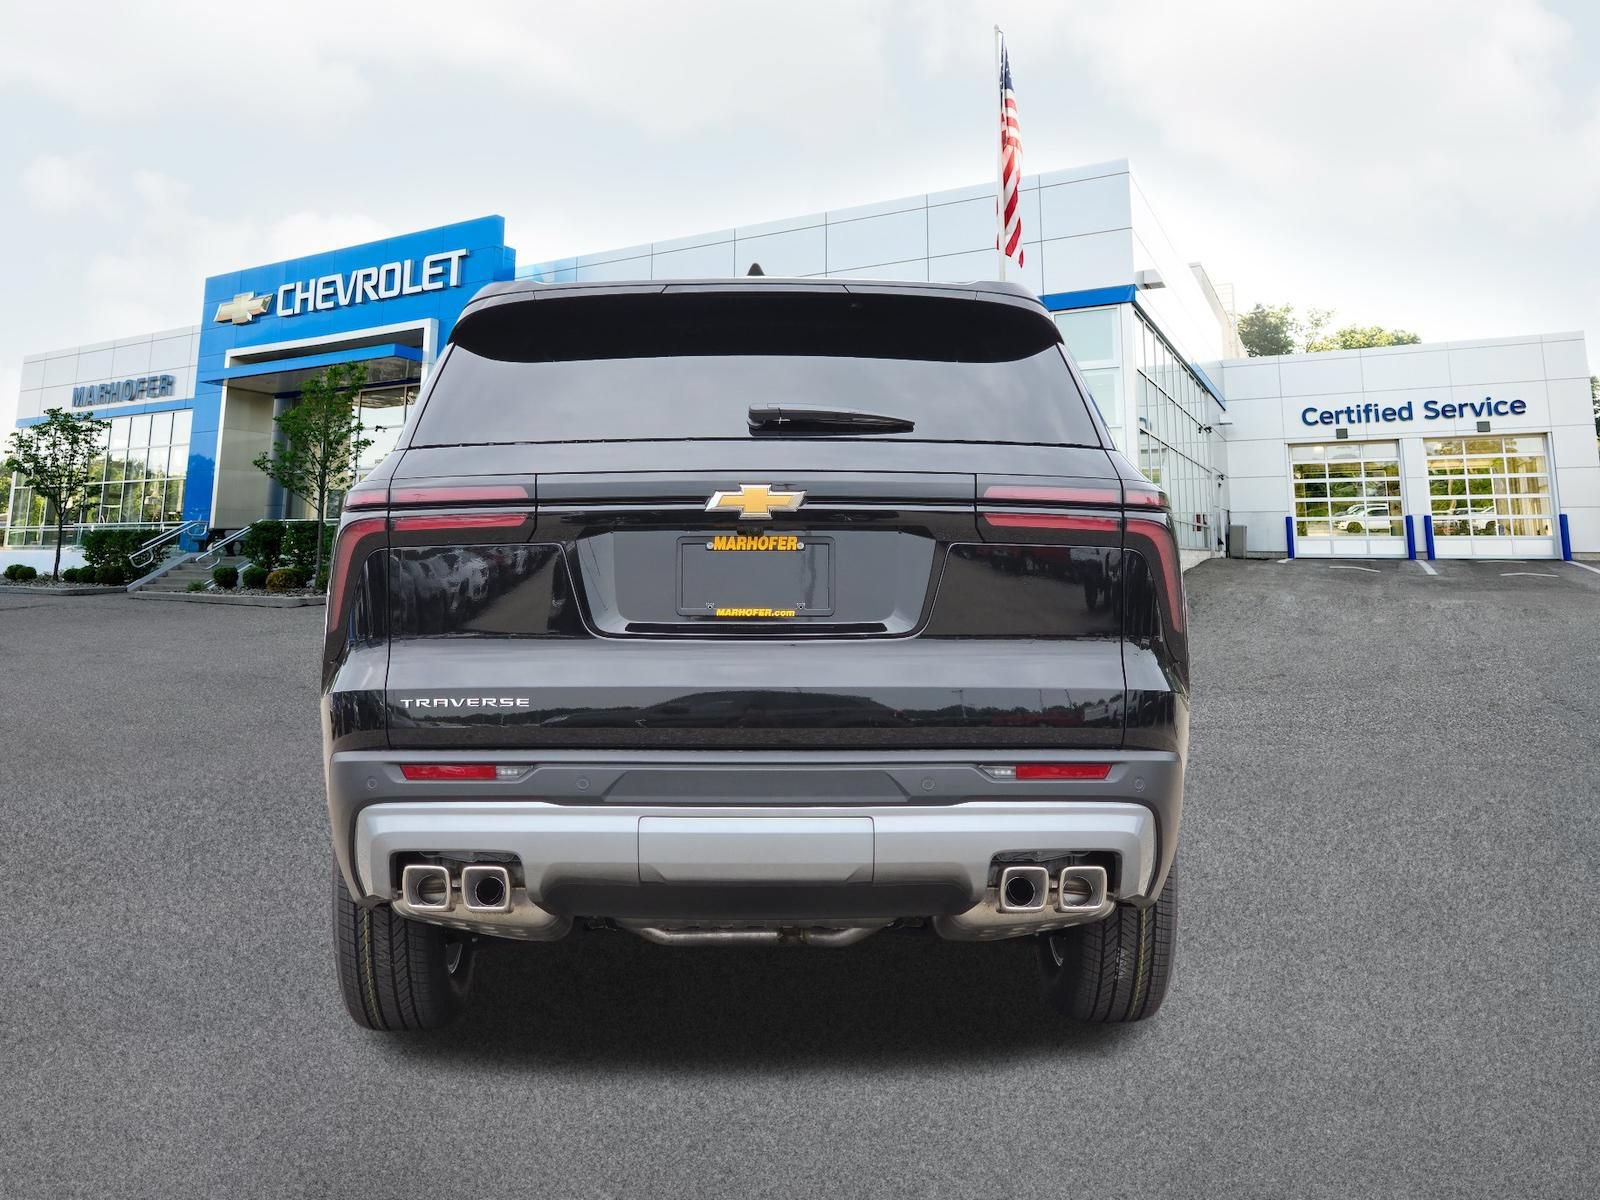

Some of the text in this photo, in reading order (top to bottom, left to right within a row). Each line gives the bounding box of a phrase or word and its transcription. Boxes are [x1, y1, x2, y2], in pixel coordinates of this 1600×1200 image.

[277, 248, 469, 317] CHEVROLET
[72, 374, 175, 408] MARHOFER
[1301, 396, 1528, 427] Certified Service
[712, 535, 799, 551] MARHOFER
[716, 607, 796, 617] MARHOFER.com
[399, 697, 530, 709] TRAVERSE
